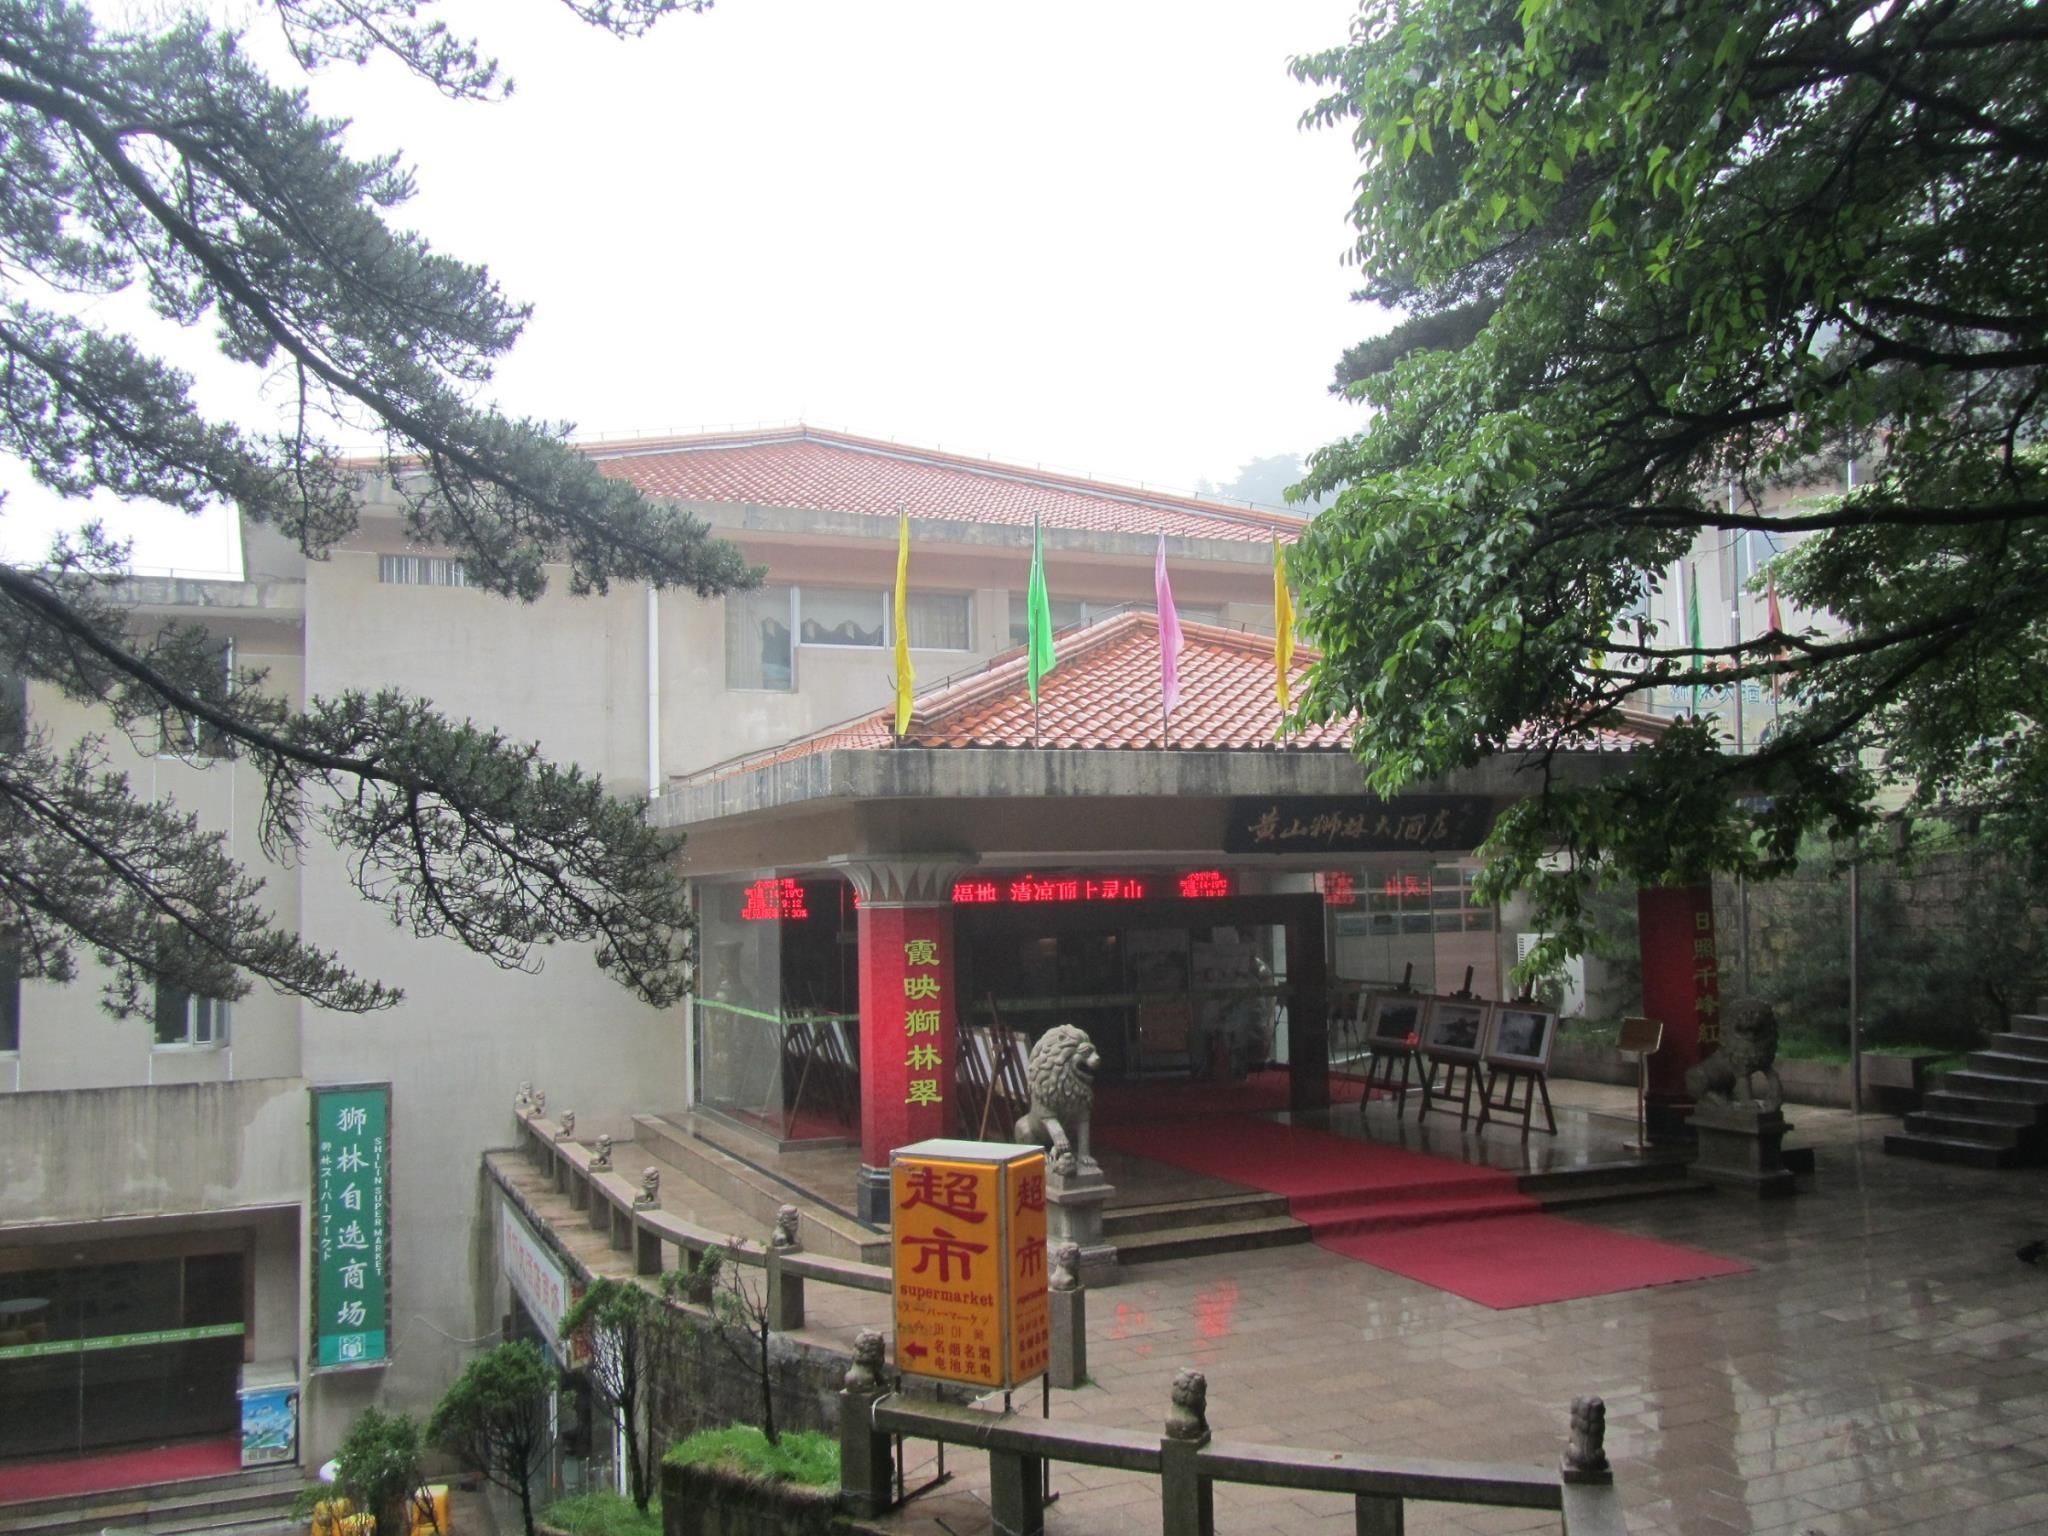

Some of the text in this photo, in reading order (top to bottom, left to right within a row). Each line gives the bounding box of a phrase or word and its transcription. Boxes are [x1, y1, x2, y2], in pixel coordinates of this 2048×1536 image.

[953, 883, 996, 901] 福地
[336, 1107, 369, 1327] 狮林自选商场
[374, 1137, 382, 1276] SHILIN SUPER MARKET
[900, 1166, 988, 1282] 超市
[1016, 1175, 1046, 1279] 超市
[900, 1285, 994, 1307] supermarket
